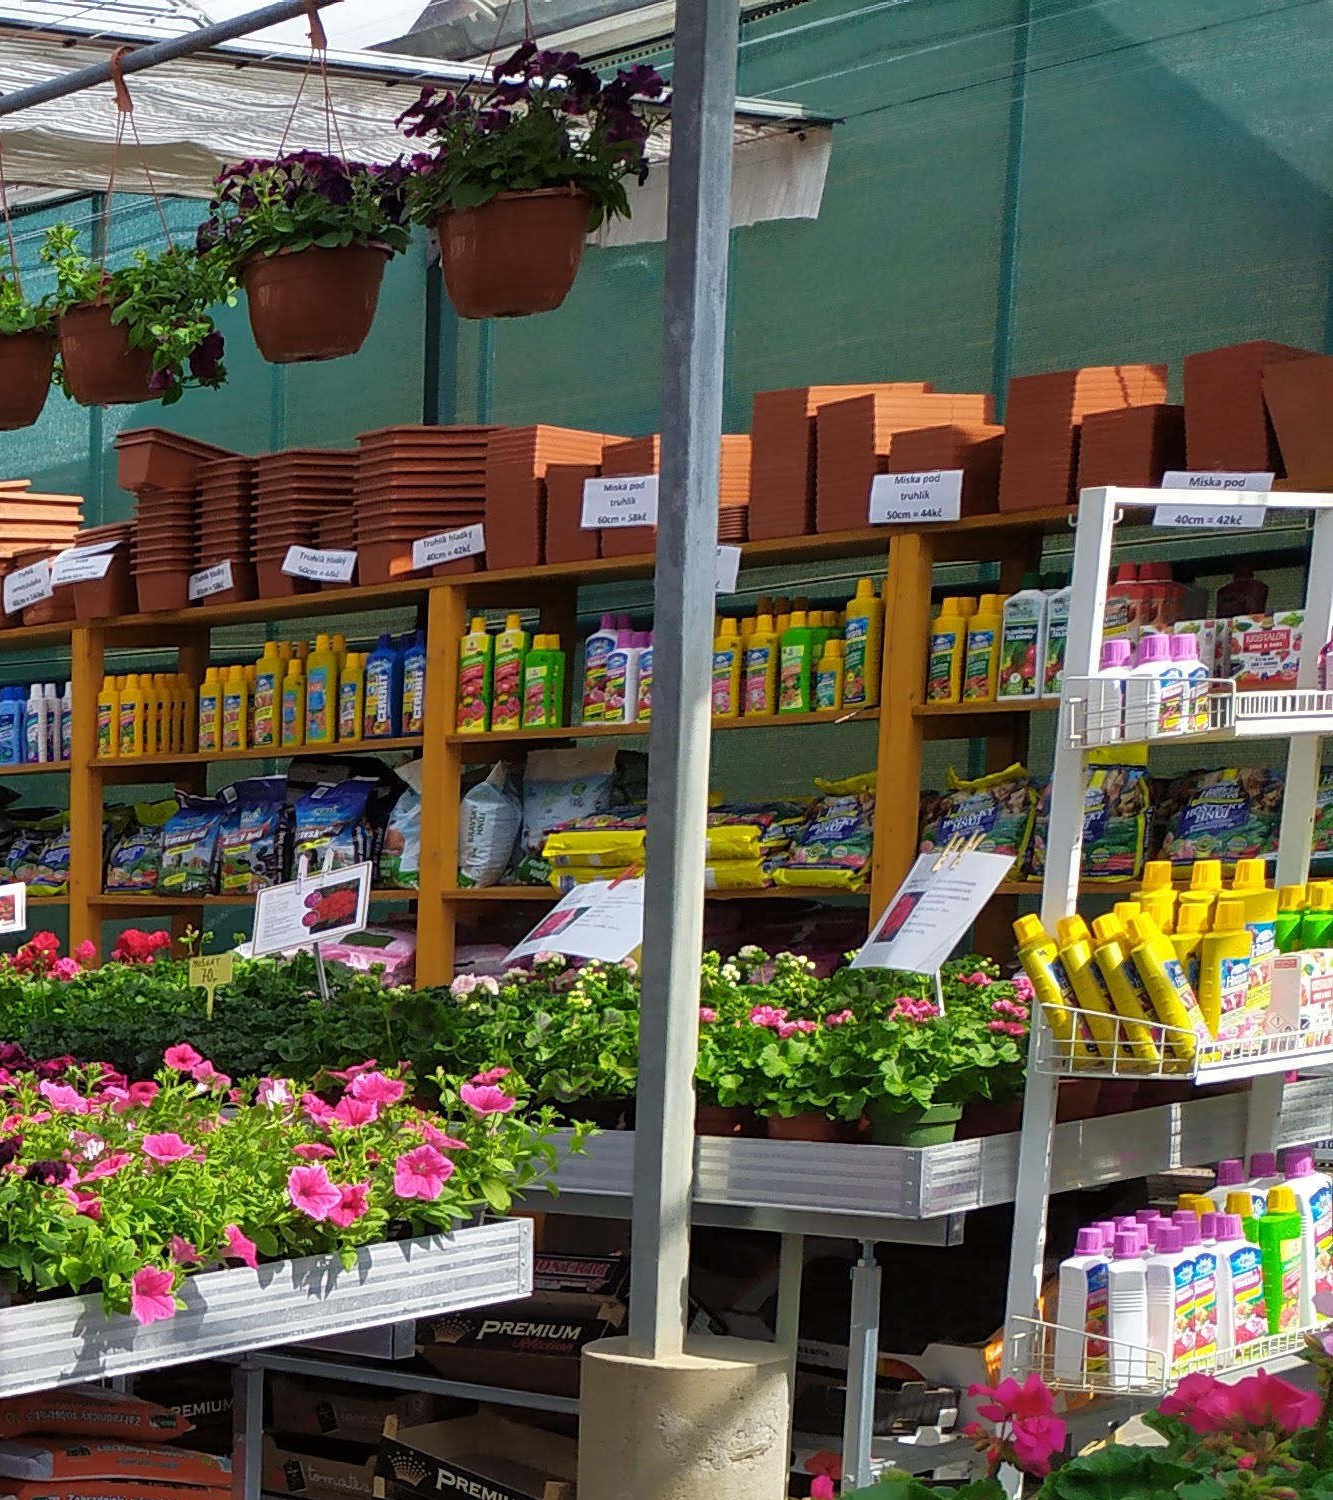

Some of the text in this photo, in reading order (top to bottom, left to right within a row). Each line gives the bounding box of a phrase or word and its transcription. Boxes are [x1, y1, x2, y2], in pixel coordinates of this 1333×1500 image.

[894, 474, 941, 484] Miska pod
[1188, 477, 1246, 489] Miska pod
[629, 481, 645, 491] pod
[886, 510, 911, 520] 50cm
[920, 508, 942, 518] 44kč
[1174, 514, 1205, 525] 40cm
[1216, 515, 1243, 525] 42kč
[476, 1320, 581, 1341] PREMIUM
[171, 1398, 234, 1419] PREMIUM
